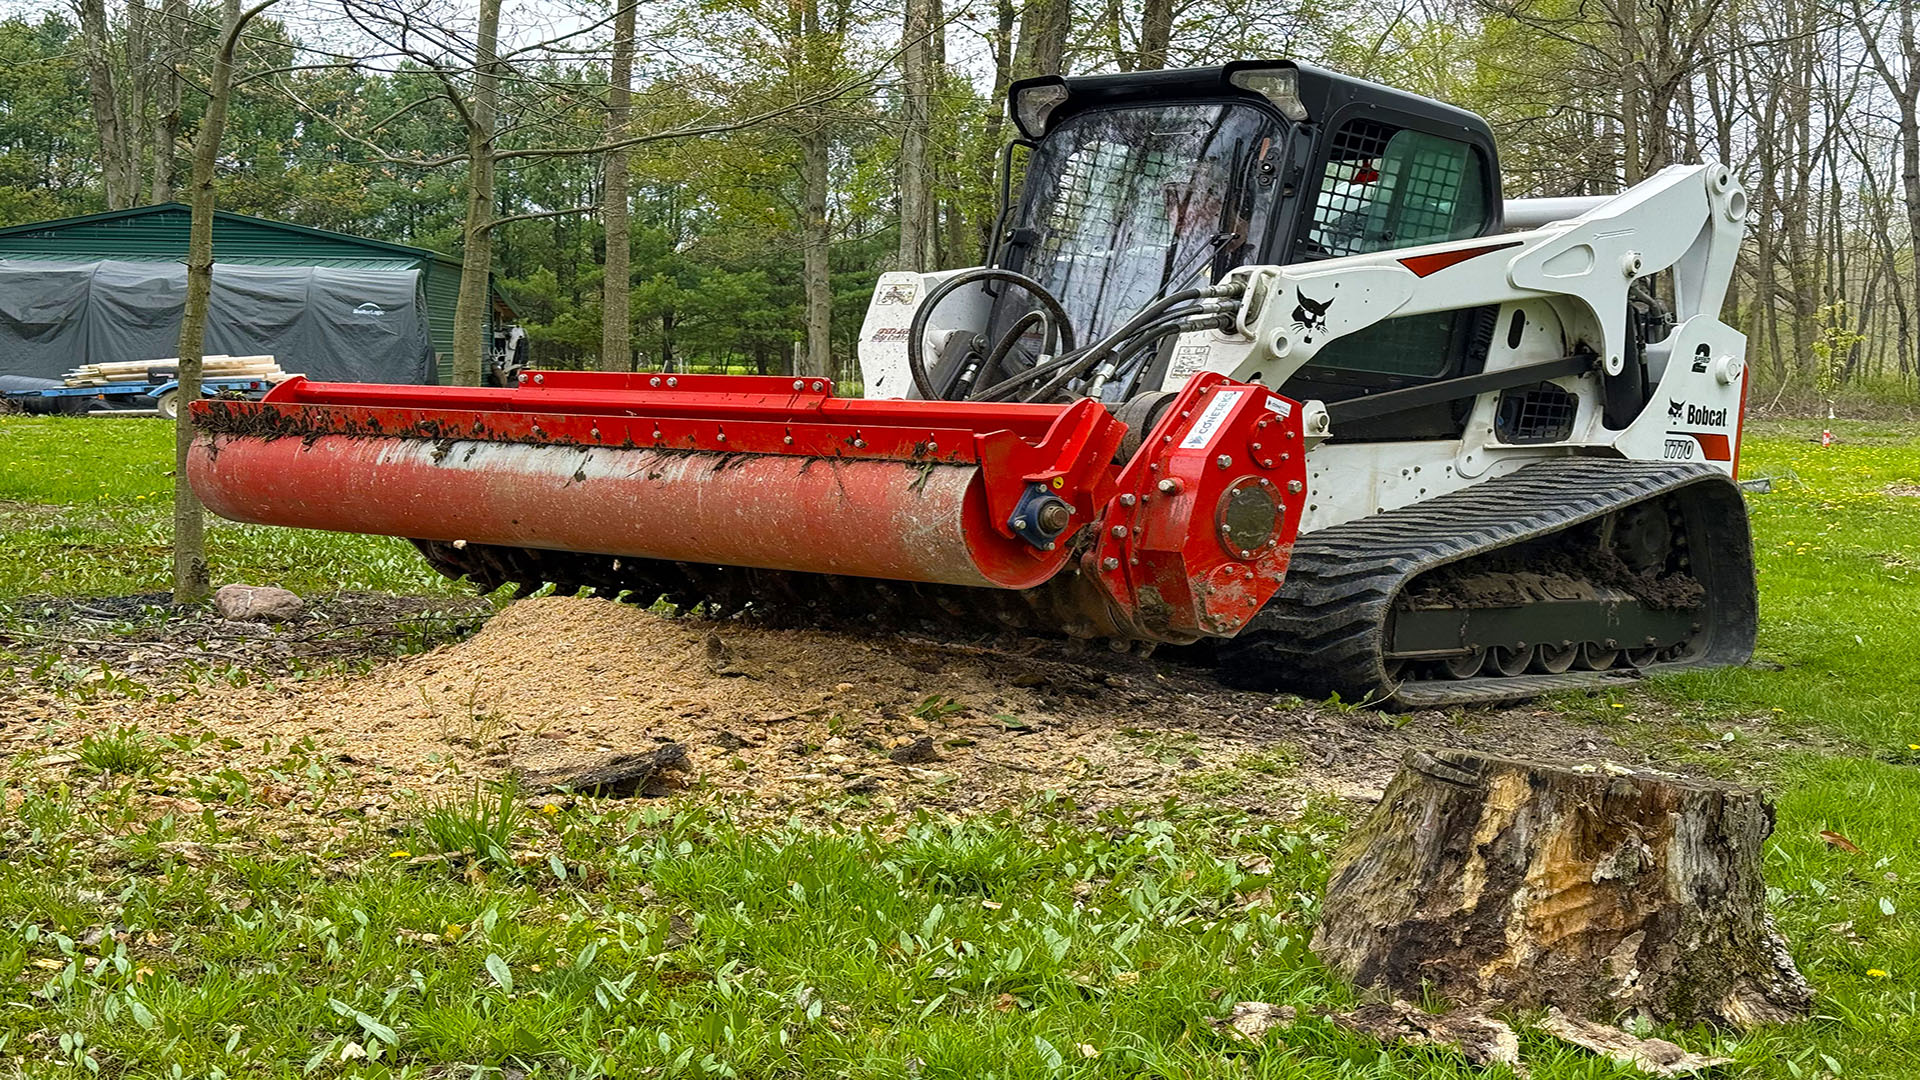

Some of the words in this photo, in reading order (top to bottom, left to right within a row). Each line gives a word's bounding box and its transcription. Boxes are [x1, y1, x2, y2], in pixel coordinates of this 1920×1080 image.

[1691, 343, 1710, 374] 2
[1694, 356, 1711, 364] SPEED
[1687, 404, 1727, 427] Bobcat
[1664, 439, 1695, 460] T770
